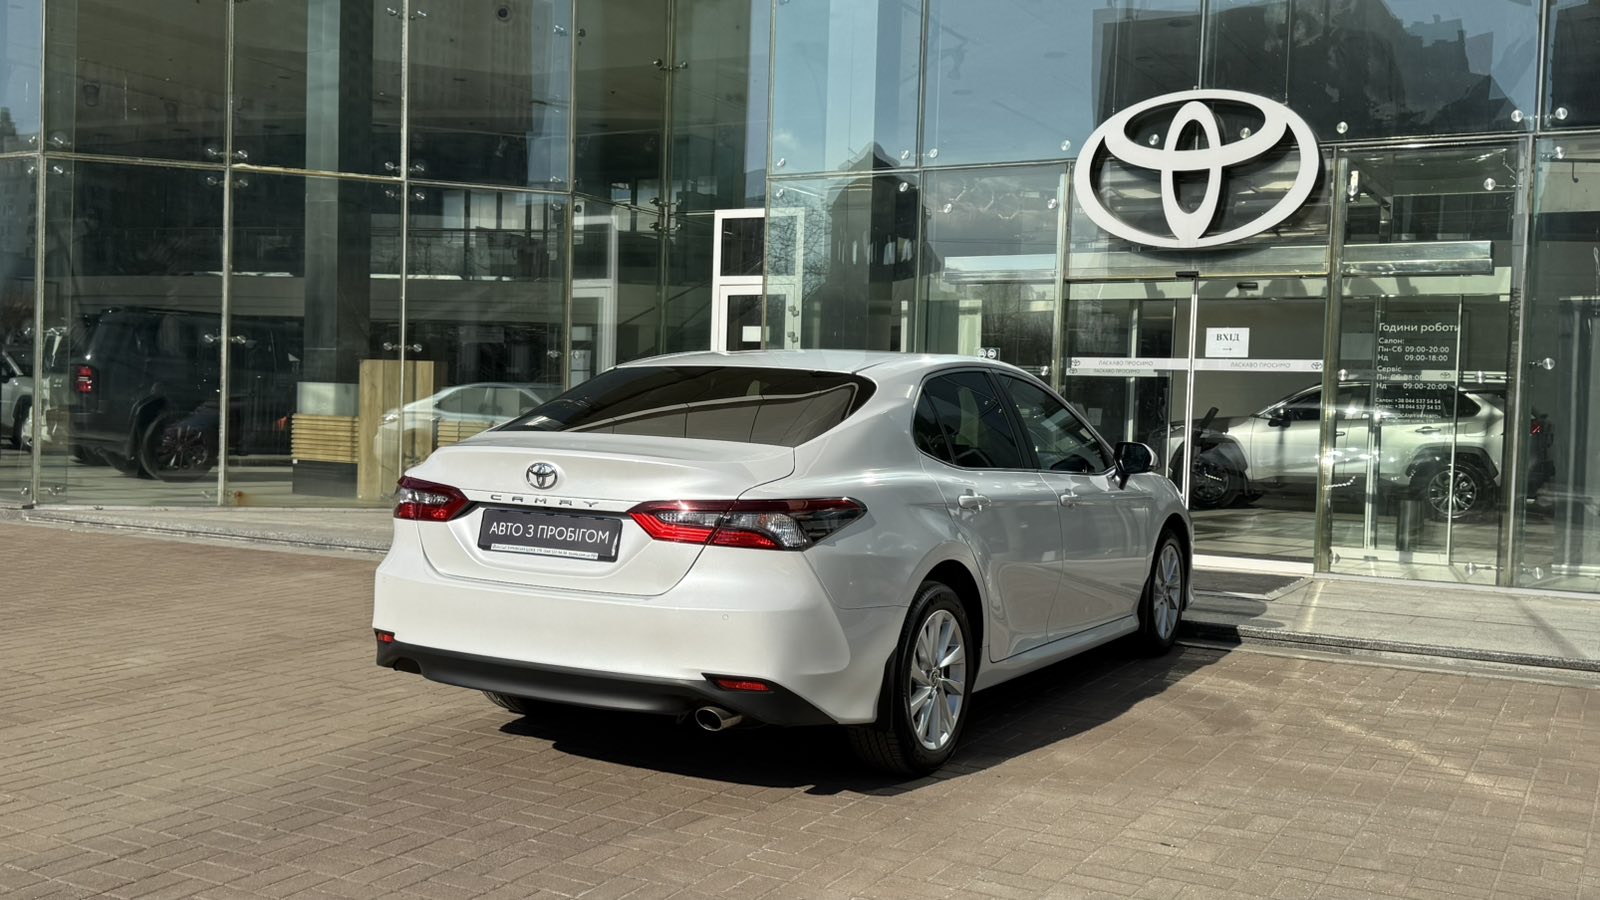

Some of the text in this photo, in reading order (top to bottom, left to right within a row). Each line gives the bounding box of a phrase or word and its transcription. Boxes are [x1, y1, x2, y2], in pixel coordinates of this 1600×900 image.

[1379, 322, 1460, 334] Години роботи
[1216, 333, 1240, 342] ВХІД
[1376, 365, 1402, 373] Сервіс
[1402, 382, 1448, 390] 09:00-20:00
[490, 494, 600, 508] CAMRY
[489, 521, 610, 544] АВТО З ПРОБІГОМ
